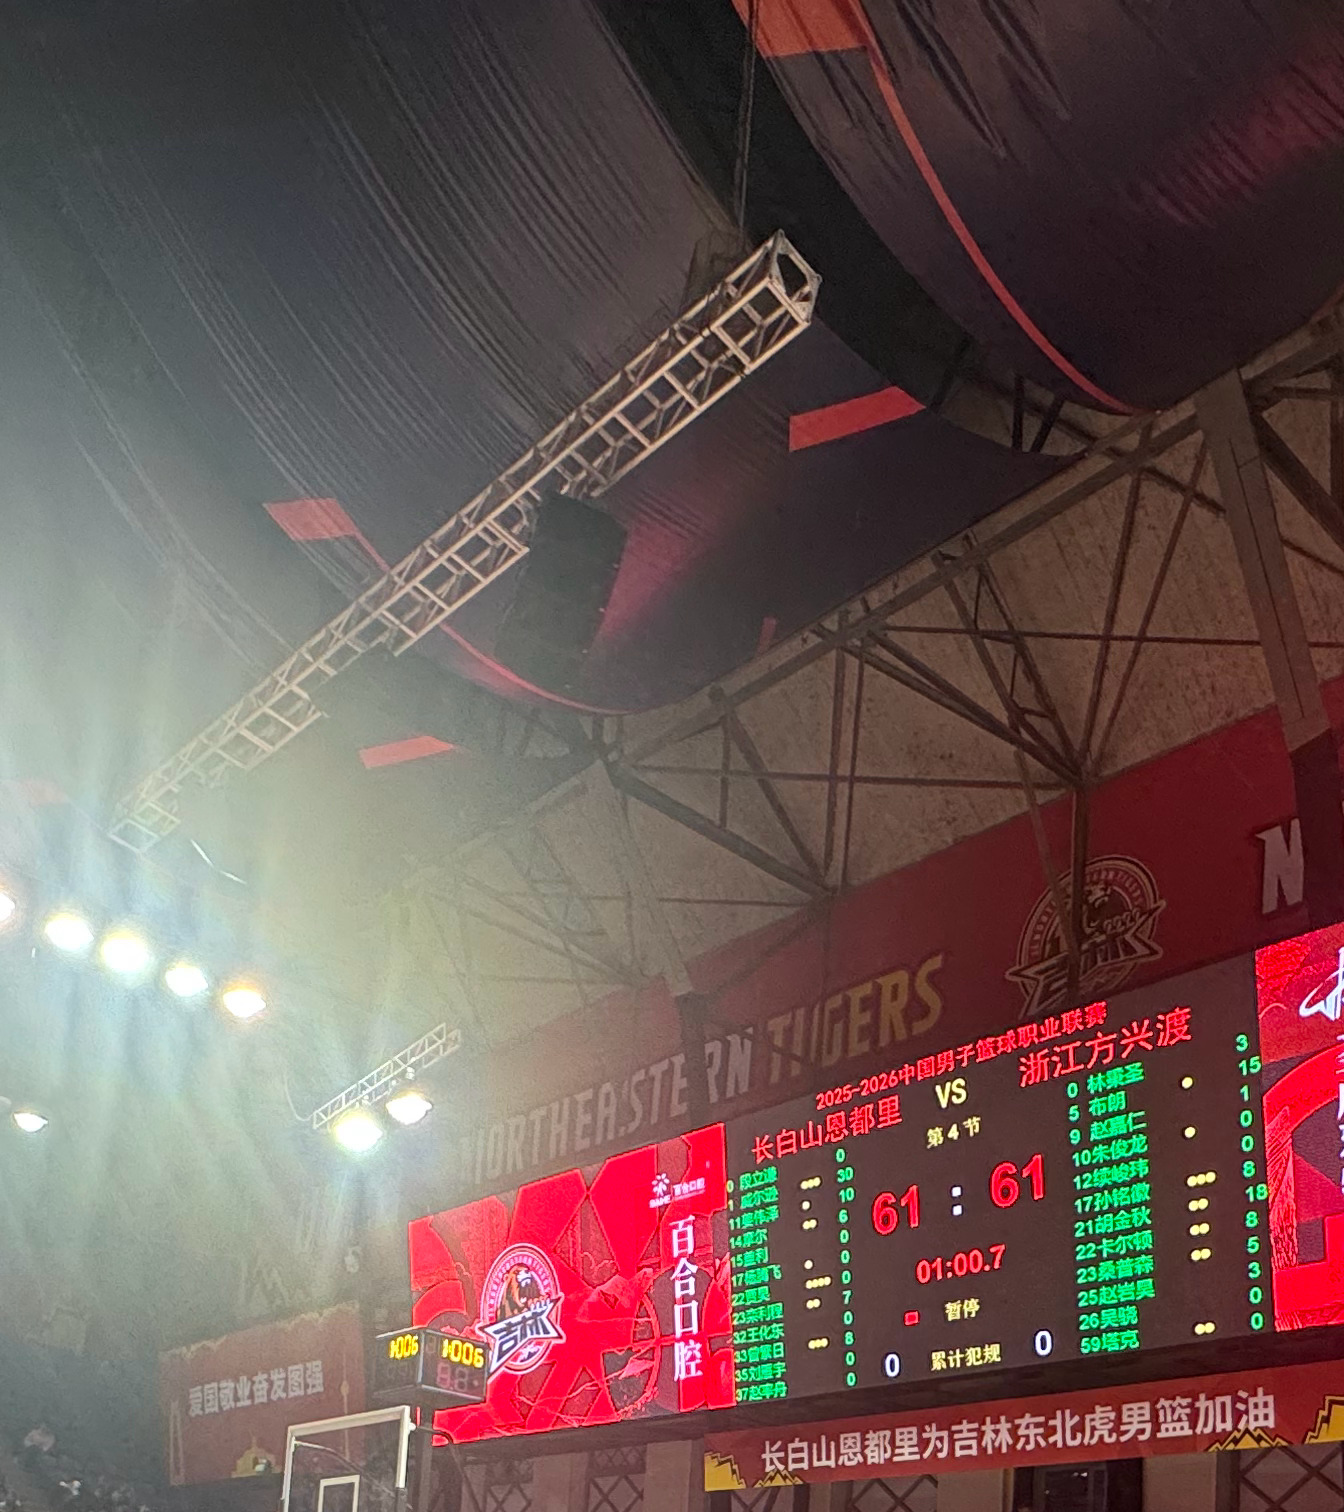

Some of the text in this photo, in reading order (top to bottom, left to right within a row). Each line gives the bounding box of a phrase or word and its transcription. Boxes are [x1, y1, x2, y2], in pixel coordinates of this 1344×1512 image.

[1019, 1006, 1192, 1088] 浙江方兴渡
[1236, 1034, 1249, 1051] 3
[1238, 1056, 1262, 1076] 15
[935, 1077, 968, 1109] VS
[1067, 1082, 1079, 1098] 0
[1240, 1085, 1250, 1101] 1
[1068, 1090, 1126, 1122] 5 布朗
[1240, 1109, 1253, 1127] 0
[751, 1095, 903, 1164] 长白山恩都里
[1069, 1128, 1081, 1145] 9
[1241, 1135, 1254, 1152] 0
[836, 1148, 846, 1163] 0
[837, 1167, 854, 1183] 30
[1242, 1161, 1256, 1177] 8
[838, 1187, 855, 1203] 10
[872, 1184, 920, 1235] 61
[989, 1153, 1045, 1208] 61
[1245, 1183, 1269, 1202] 18
[839, 1209, 849, 1224] 6
[1245, 1211, 1259, 1228] 8
[840, 1229, 850, 1244] 0
[1246, 1236, 1260, 1253] 5
[841, 1249, 851, 1264] 0
[916, 1244, 1006, 1284] 01:00.7
[842, 1270, 852, 1284] 0
[1248, 1261, 1261, 1279] 3
[669, 1214, 703, 1382] 百合口腔
[842, 1290, 852, 1305] 7
[1249, 1287, 1263, 1304] 0
[843, 1310, 854, 1325] 0
[944, 1298, 980, 1321] 暂停
[1250, 1312, 1264, 1330] 0
[844, 1331, 855, 1346] 8
[1034, 1330, 1053, 1356] 0
[845, 1351, 856, 1366] 0
[884, 1353, 901, 1378] 0
[930, 1343, 1002, 1371] 累计犯规
[846, 1372, 857, 1387] 0
[761, 1388, 1275, 1473] 长白山恩都里为吉林东北虎男篮加油
